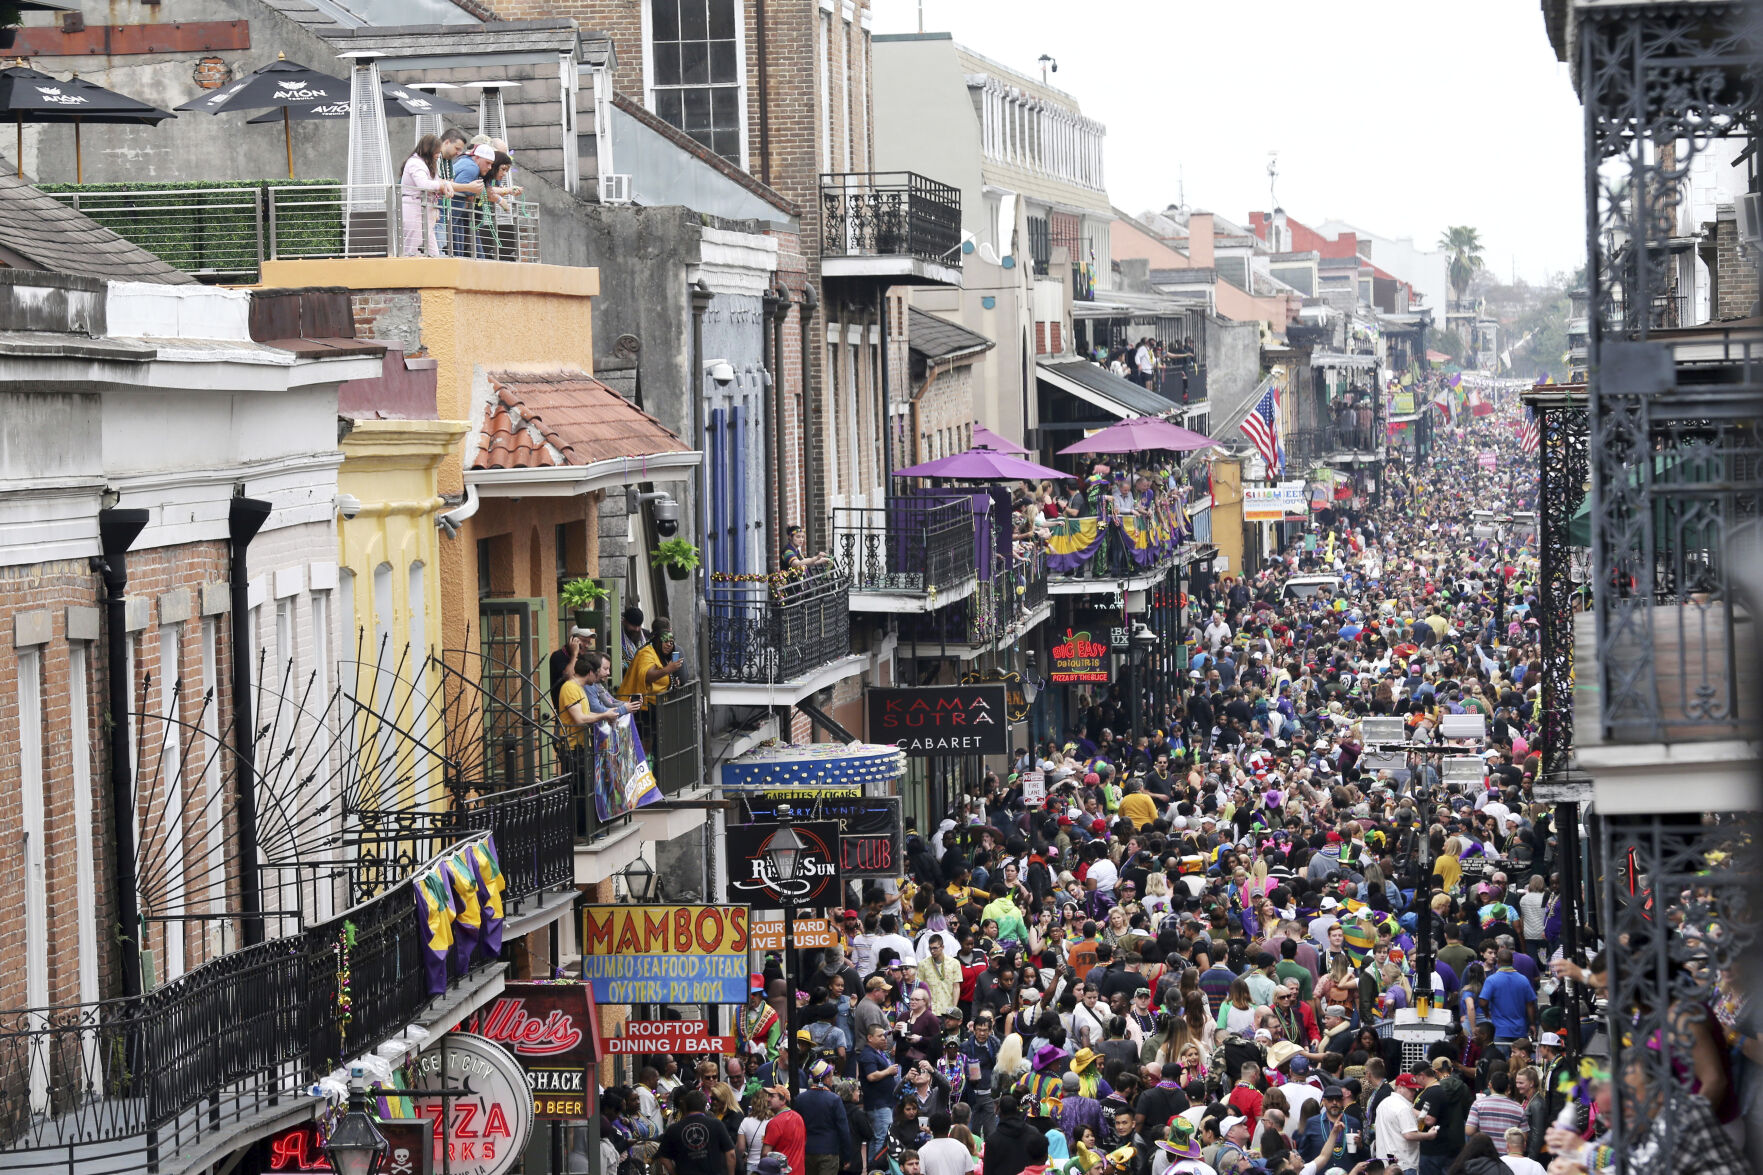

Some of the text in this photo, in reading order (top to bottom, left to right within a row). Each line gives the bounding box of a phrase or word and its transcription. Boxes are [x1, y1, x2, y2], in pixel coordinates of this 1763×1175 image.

[310, 104, 351, 113] AVIÓ
[1052, 640, 1107, 659] BIG EASY
[886, 696, 990, 712] KAMA
[883, 711, 995, 727] SUTRA
[896, 736, 982, 750] CABARET
[773, 808, 811, 817] LRRY
[857, 839, 891, 870] CLUB
[804, 857, 836, 876] SUN
[586, 907, 748, 955] MAMBO'S
[751, 921, 826, 935] COURYARD
[751, 936, 776, 949] IVE
[584, 956, 748, 979] GUMBO SEAFOOD STEAKS
[609, 981, 663, 1003] OYSTERS
[629, 1022, 704, 1035] ROOFTOP
[609, 1038, 671, 1052] DINING
[685, 1038, 723, 1051] BAR
[462, 1054, 494, 1080] CITY
[528, 1072, 582, 1091] SHACK
[547, 1101, 582, 1115] BEER
